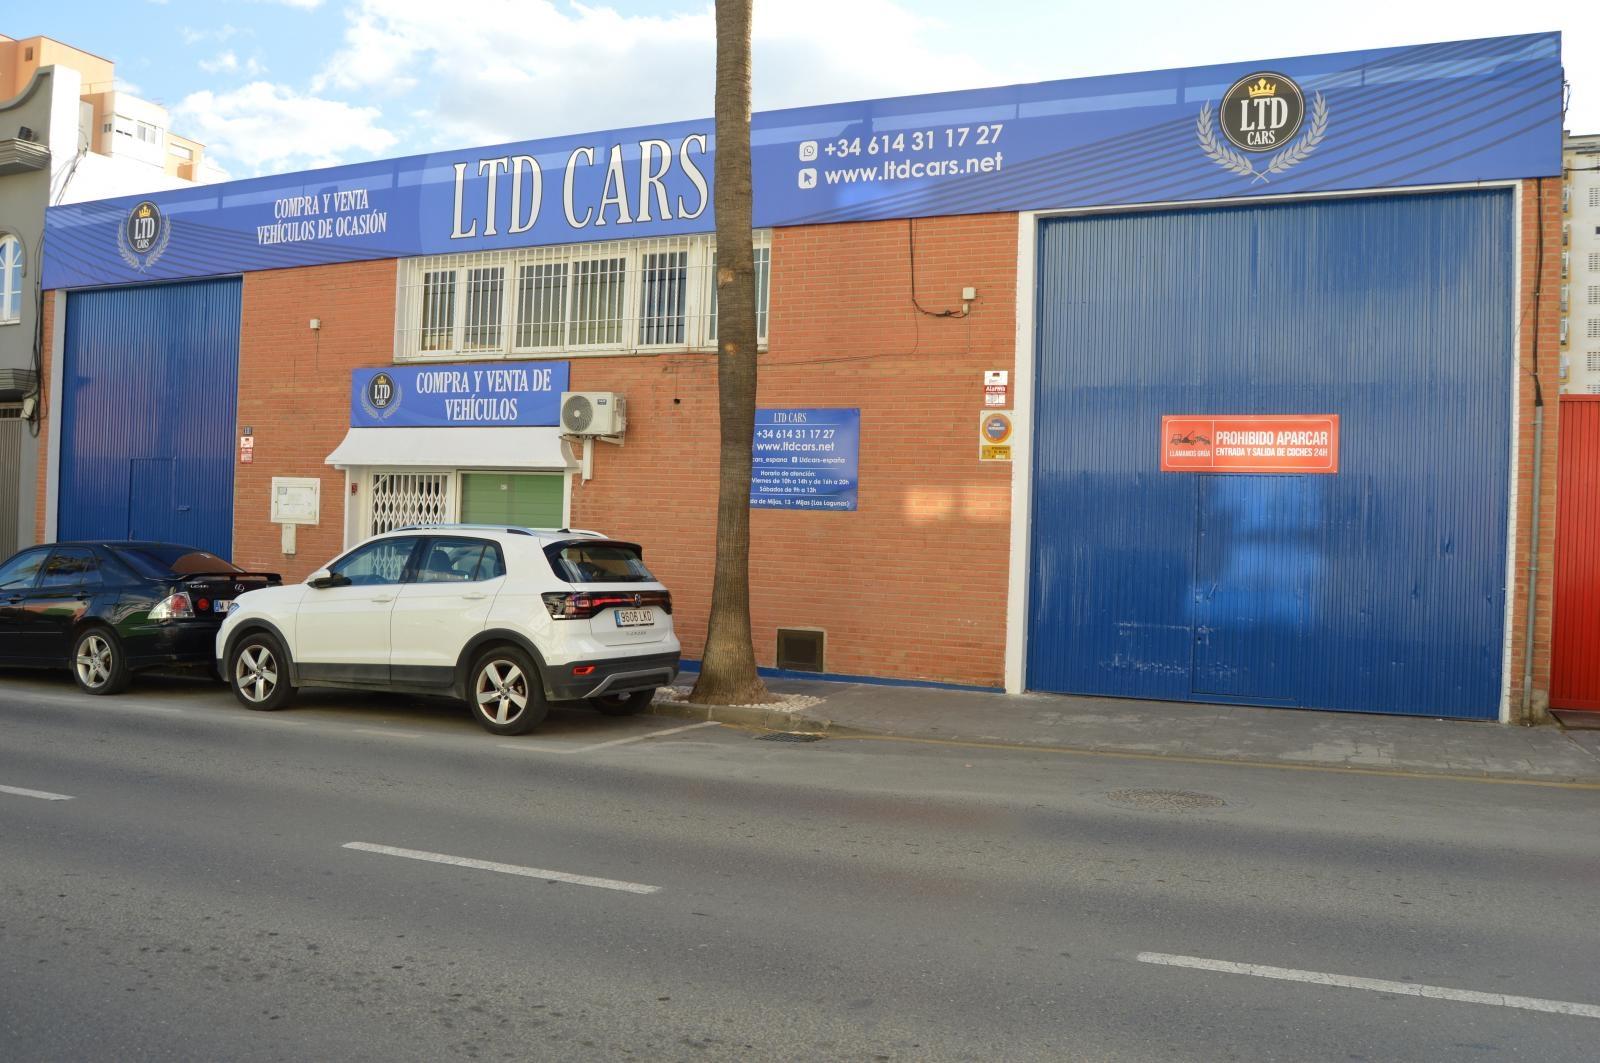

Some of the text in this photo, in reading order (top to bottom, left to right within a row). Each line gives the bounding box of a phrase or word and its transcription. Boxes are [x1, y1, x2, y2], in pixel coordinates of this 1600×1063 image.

[1240, 97, 1288, 131] LTD
[824, 124, 1004, 158] +34 614 31 17 27
[1247, 130, 1276, 146] CARS
[824, 152, 1004, 184] www.ltdcars.net
[450, 133, 709, 240] LTD CARS
[274, 189, 368, 218] COMPRA Y VENTA
[134, 218, 154, 240] LTD
[256, 208, 387, 245] VEHÍCULOS DE OCASIÓN
[374, 384, 390, 399] LTD
[416, 368, 552, 394] COMPRA Y VENTA DE
[445, 394, 518, 421] VEHÍCULOS
[774, 412, 807, 423] LTD CARS
[756, 430, 835, 439] +34 614 31 17 27
[1216, 431, 1328, 446] PROHIBIDO APARCAR
[756, 442, 835, 452] www.ltdcars.net
[1216, 448, 1328, 457] ENTRADA Y SALIDA DE COCHES 24H
